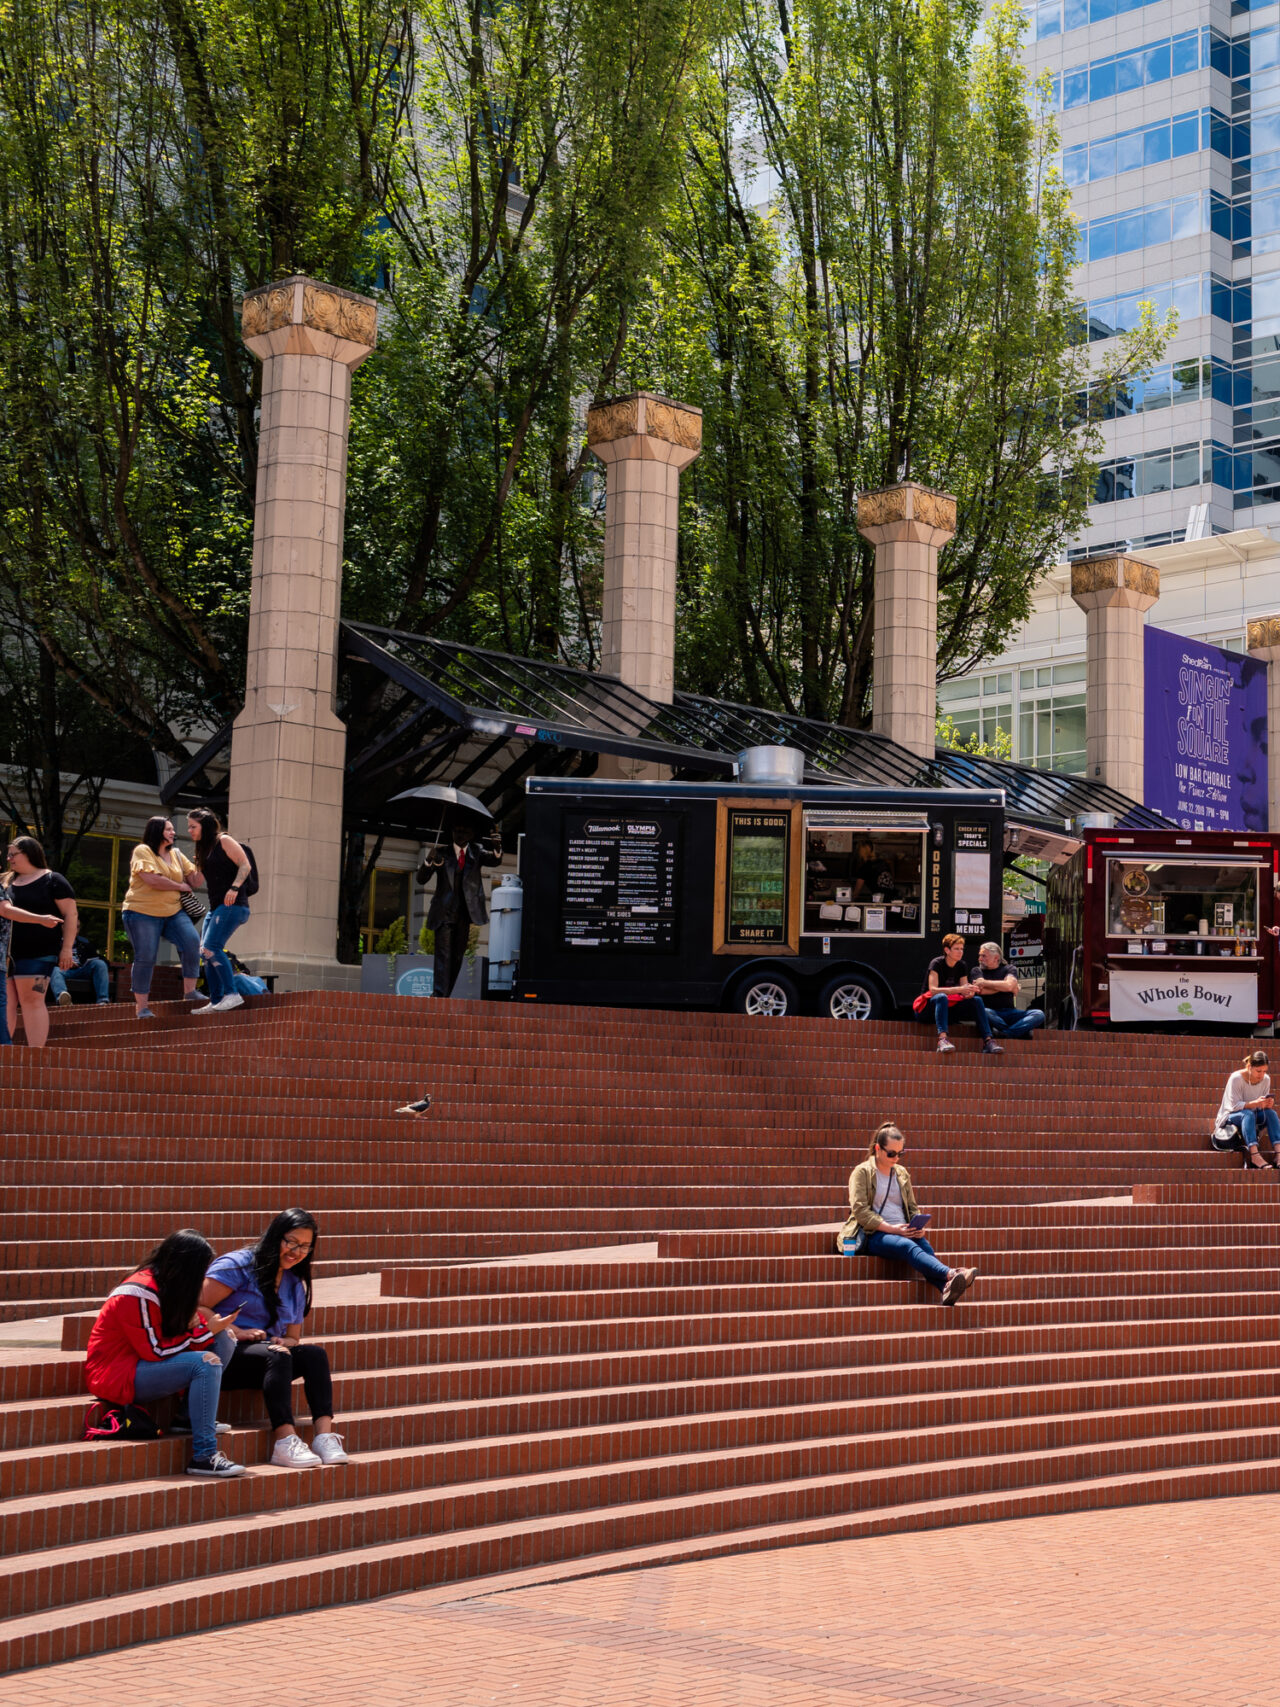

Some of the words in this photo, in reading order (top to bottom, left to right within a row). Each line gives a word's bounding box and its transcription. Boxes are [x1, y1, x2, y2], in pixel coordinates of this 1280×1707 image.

[1179, 667, 1234, 705] SINGIN'
[1192, 703, 1204, 730] IN
[1206, 698, 1229, 746] THE
[1178, 717, 1229, 765] SQUARE
[1175, 763, 1188, 779] LOW
[1190, 766, 1202, 782] BAR
[1203, 769, 1231, 789] CHORALE
[735, 817, 751, 825] THIS
[754, 818, 761, 826] IS
[763, 818, 786, 826] GOOD.
[1205, 806, 1215, 818] 7PM
[1220, 809, 1229, 820] 9PM
[587, 825, 620, 833] Tillamook
[932, 850, 941, 915] ORDER
[740, 929, 765, 937] SHARE
[956, 925, 985, 934] MENUS
[1137, 985, 1189, 1005] Whole
[1194, 985, 1232, 1008] Bowl
